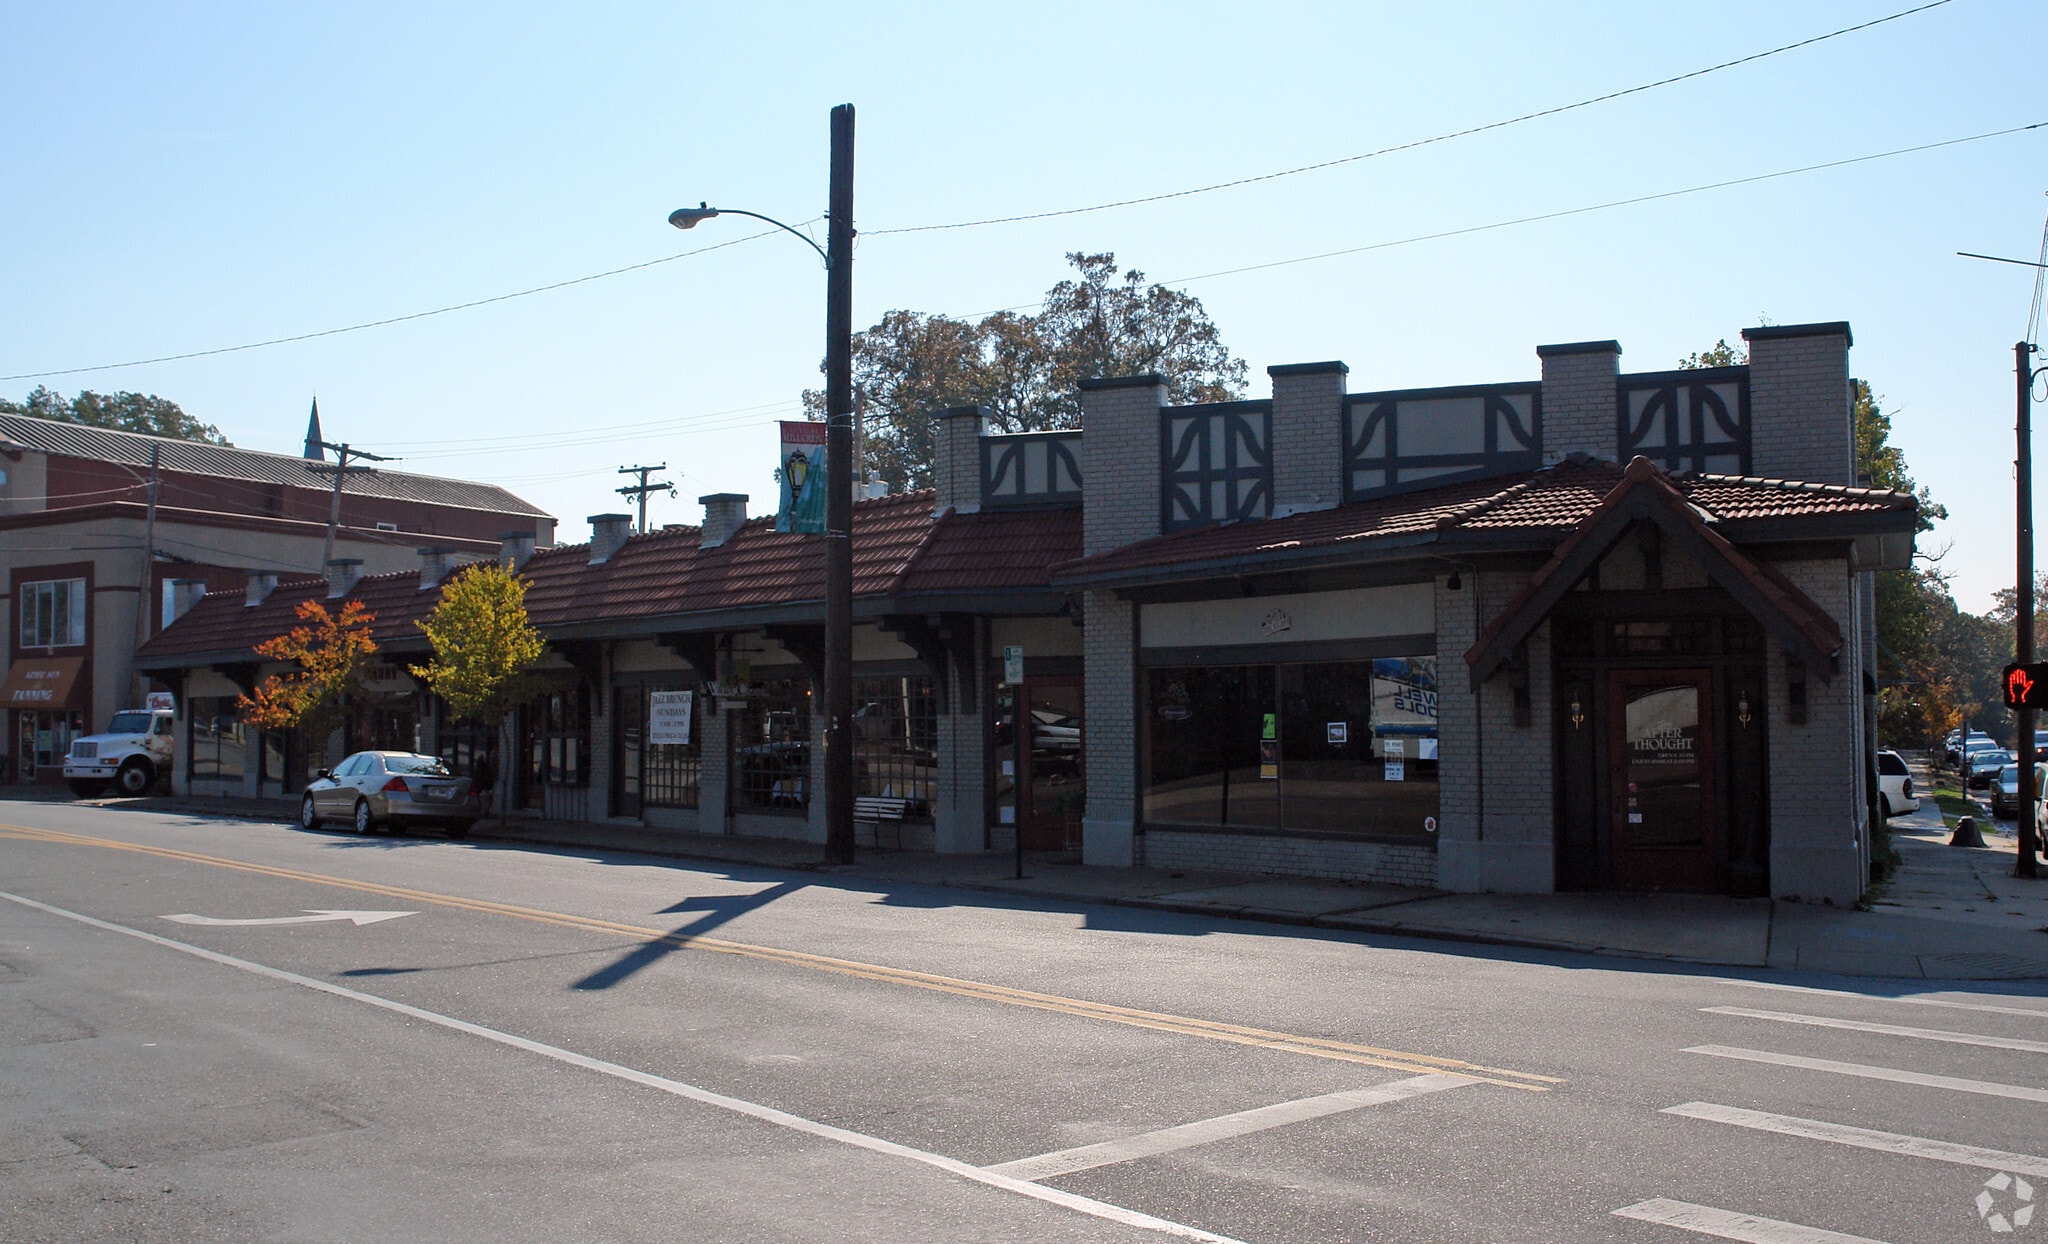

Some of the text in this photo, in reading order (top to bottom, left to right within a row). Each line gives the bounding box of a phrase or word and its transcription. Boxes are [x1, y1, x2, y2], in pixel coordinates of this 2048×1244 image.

[12, 689, 53, 701] TANNING
[658, 708, 686, 716] SUNDAYS
[1643, 727, 1682, 738] AFTER
[1633, 738, 1694, 750] THOUGHT
